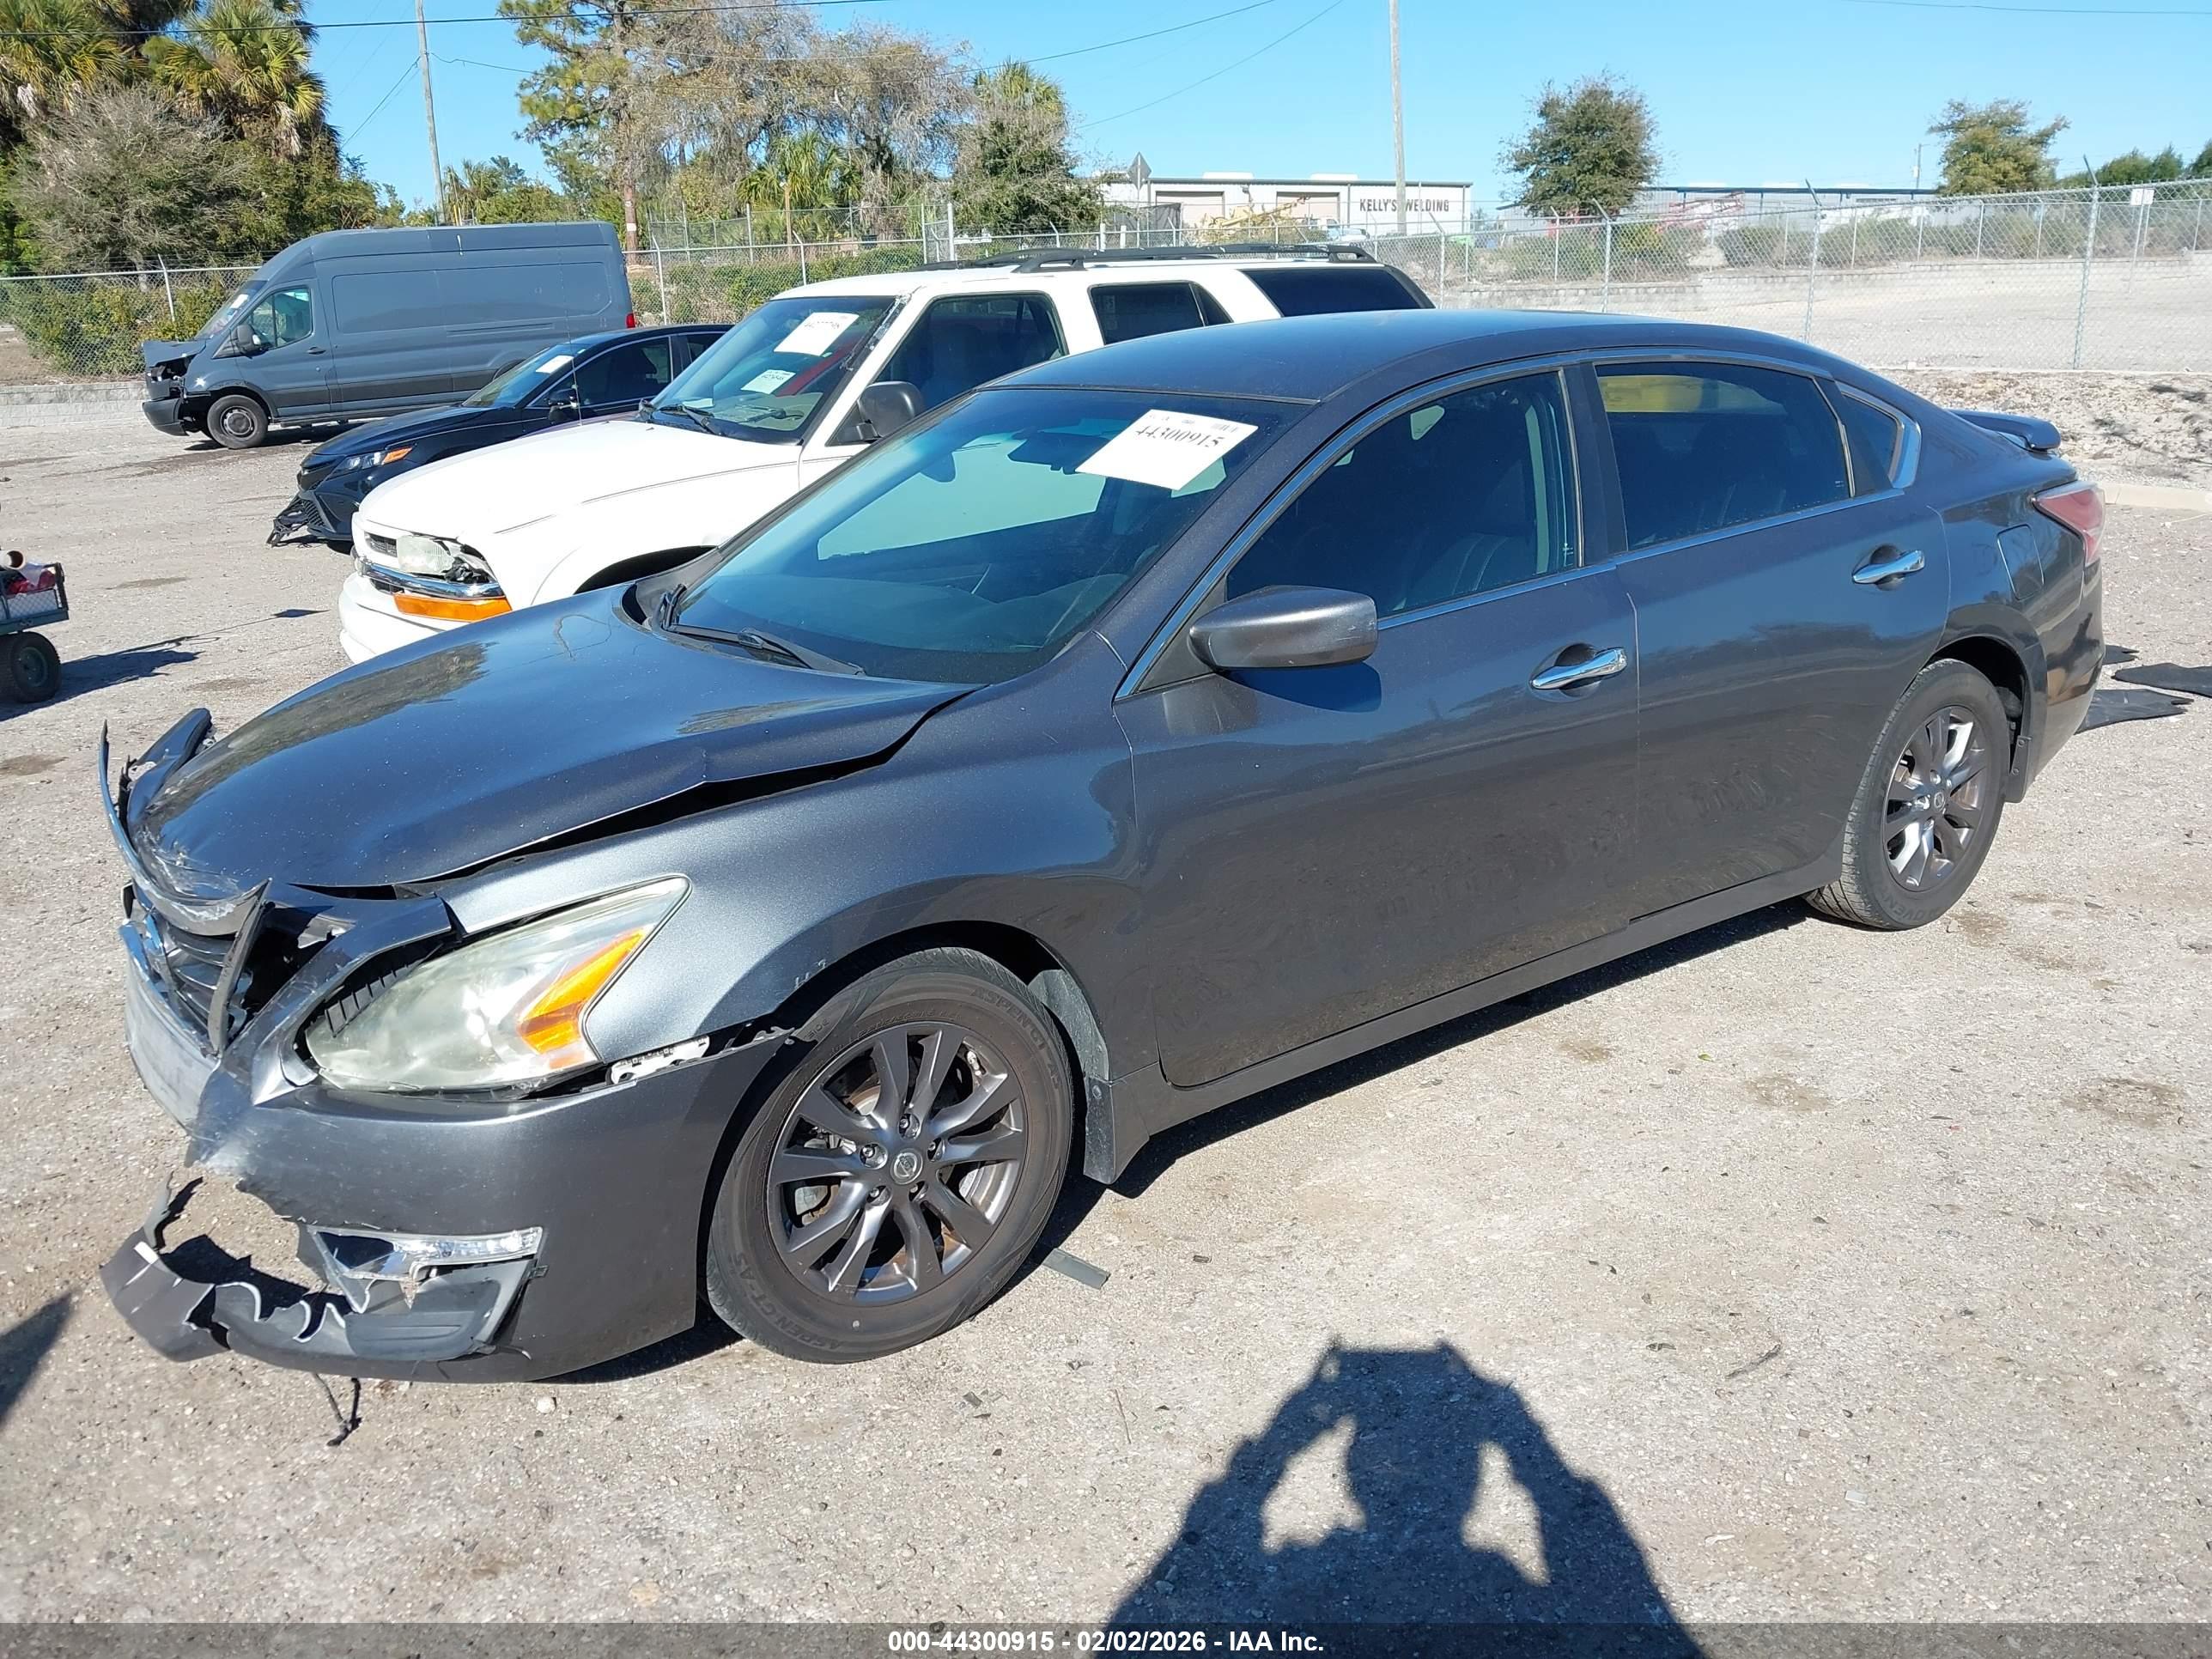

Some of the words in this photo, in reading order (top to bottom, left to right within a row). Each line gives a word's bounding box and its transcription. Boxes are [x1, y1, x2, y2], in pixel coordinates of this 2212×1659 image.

[1359, 198, 1398, 212] KELLY'S
[1405, 198, 1449, 212] WELDING
[1134, 425, 1226, 448] 44300915
